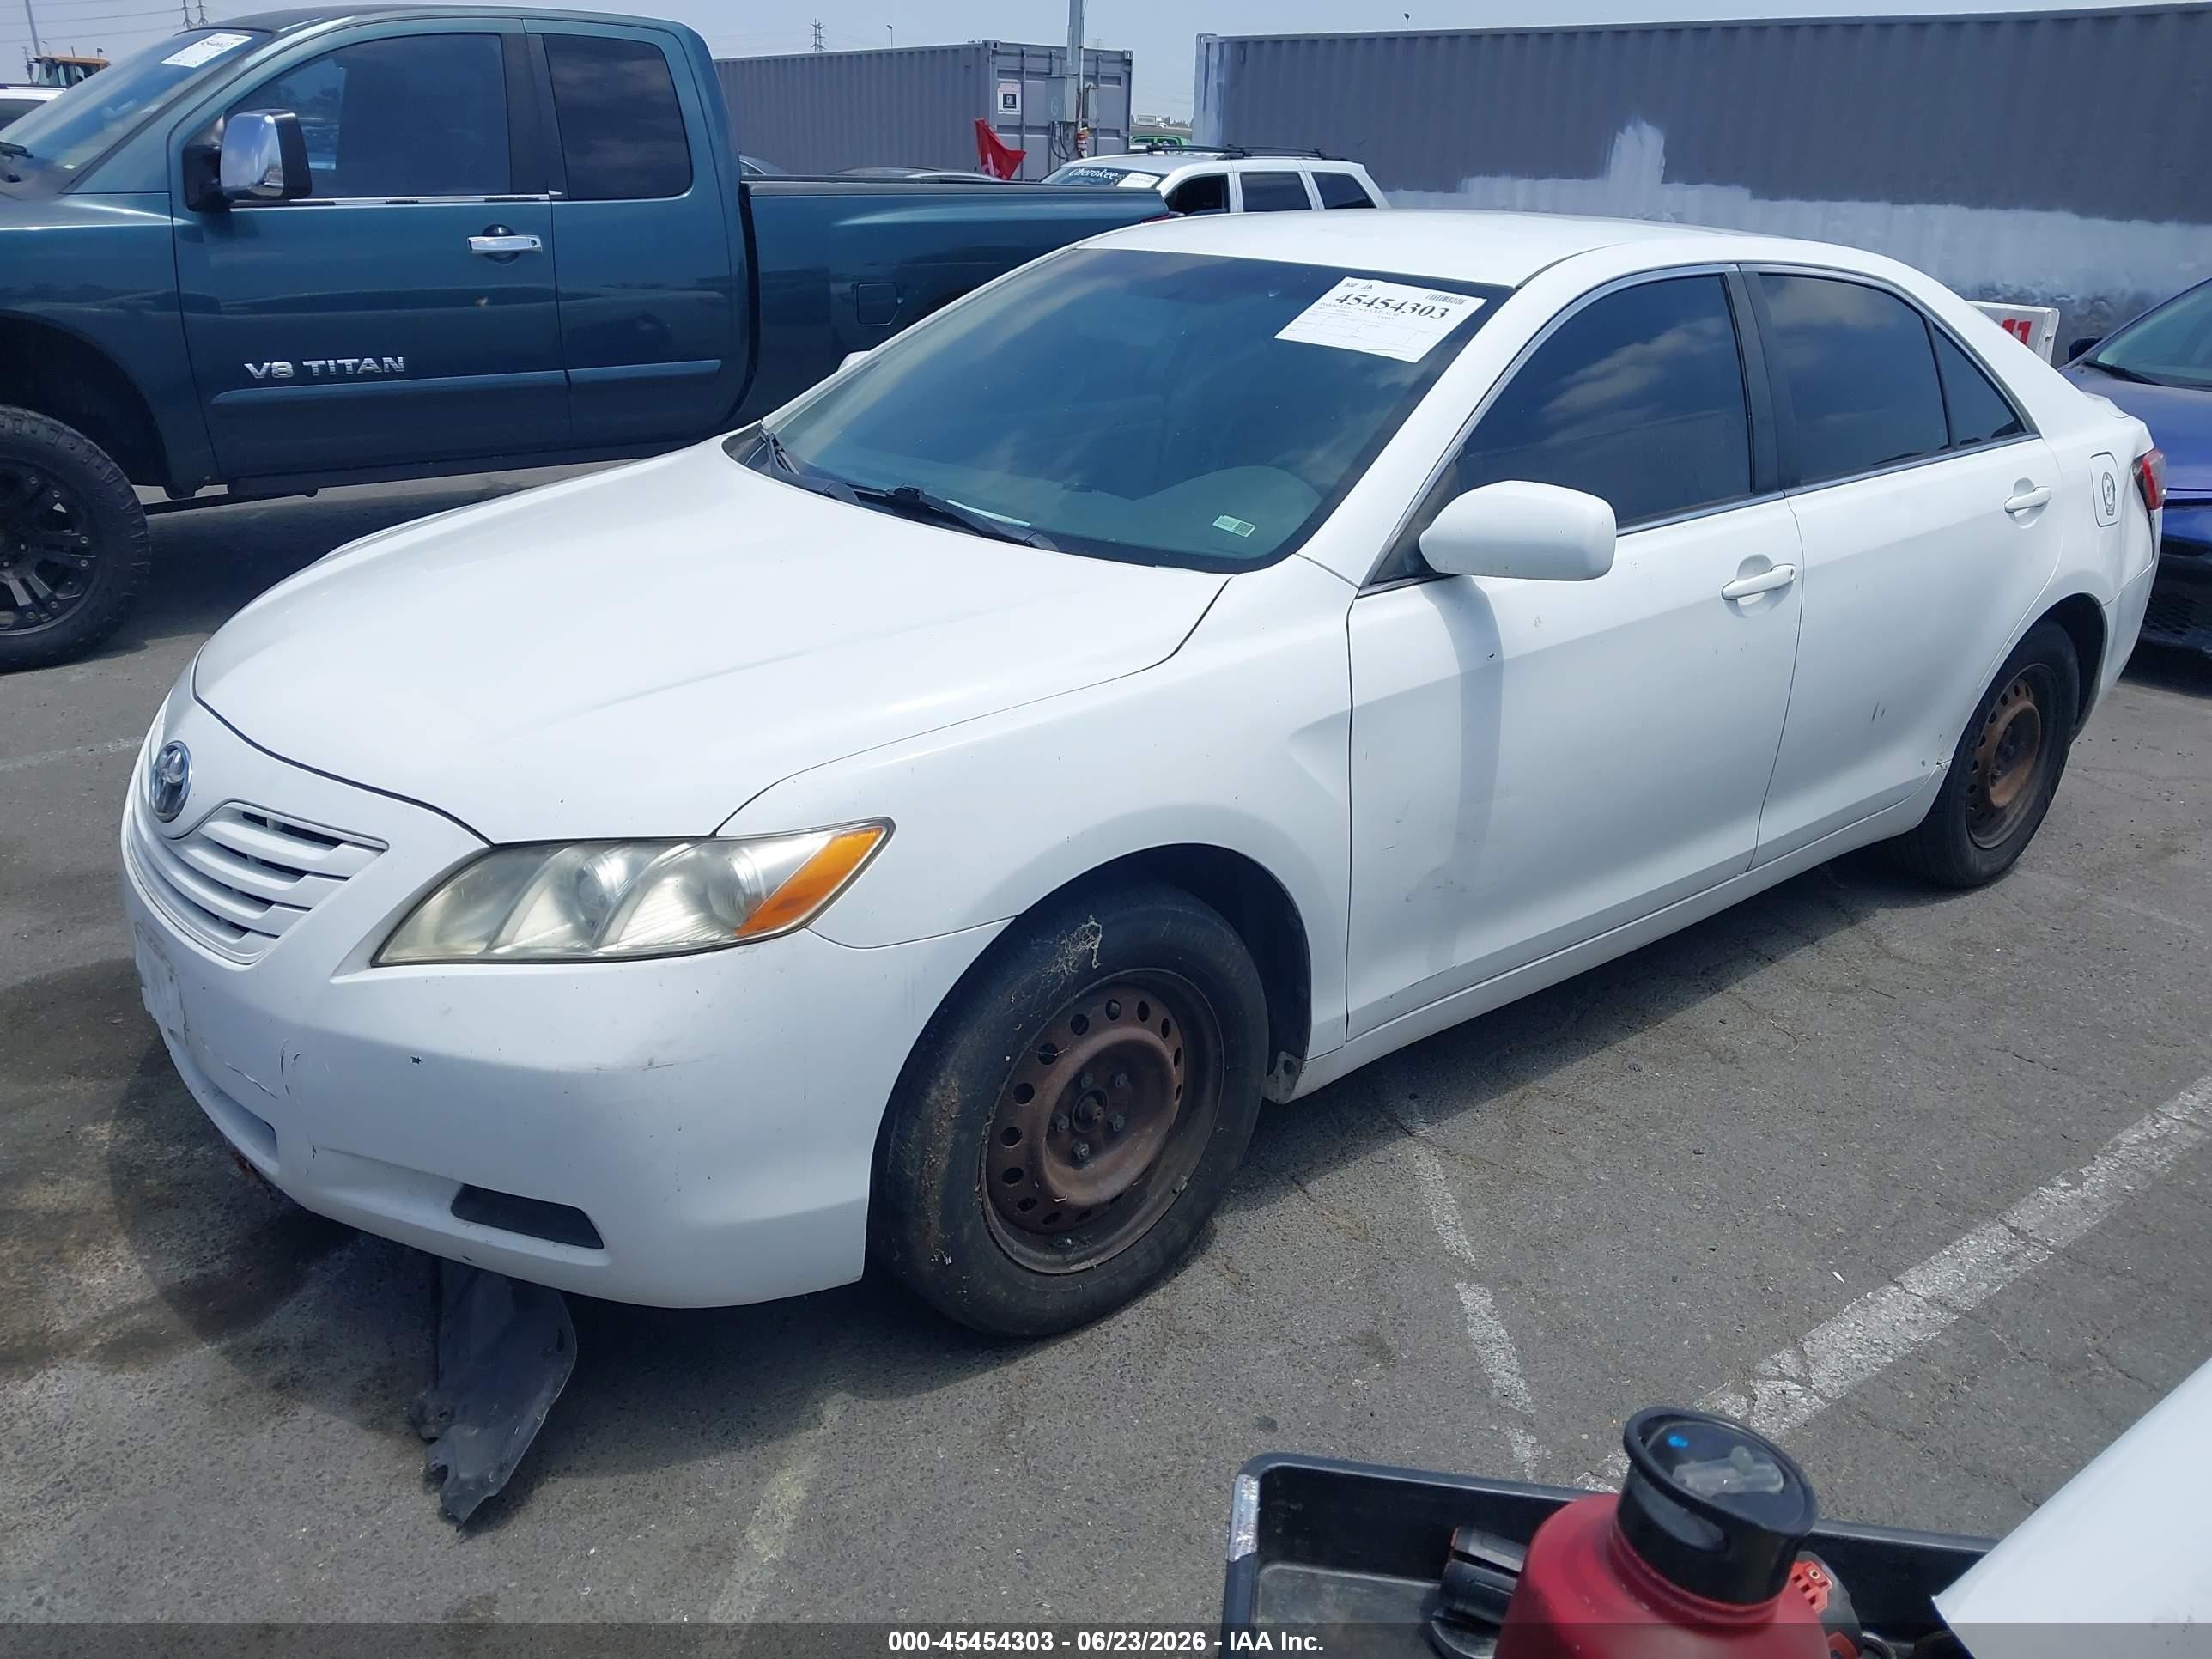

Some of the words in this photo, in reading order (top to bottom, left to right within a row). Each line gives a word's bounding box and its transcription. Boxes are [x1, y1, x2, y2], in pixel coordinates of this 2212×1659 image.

[1335, 293, 1449, 319] 45454303
[244, 361, 294, 379] V8
[302, 356, 405, 376] TITAN
